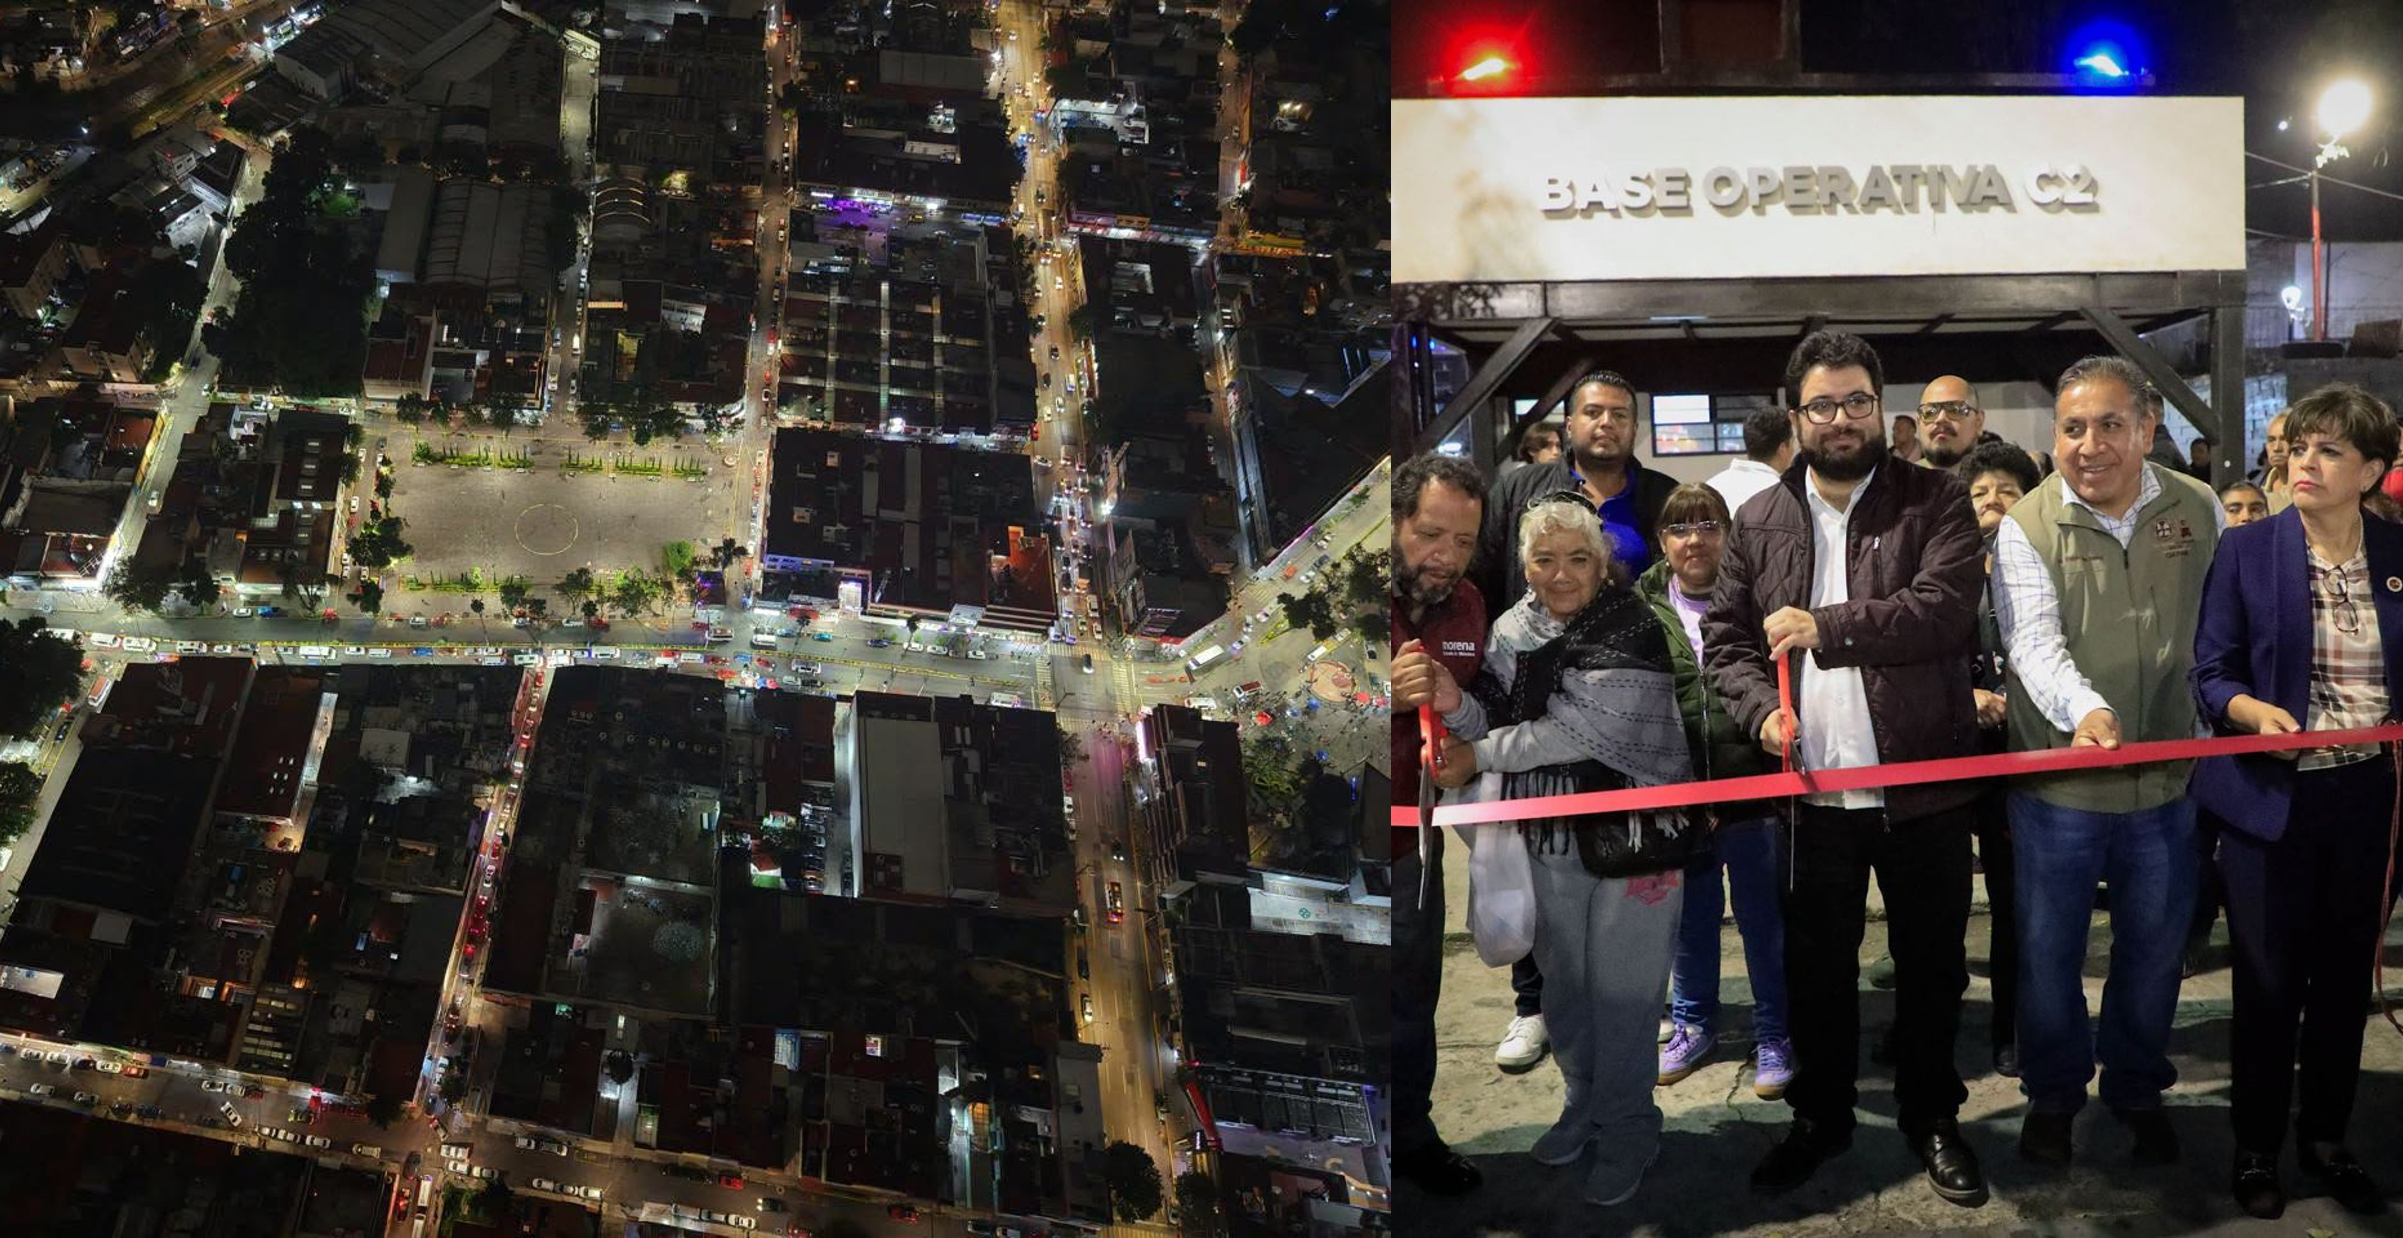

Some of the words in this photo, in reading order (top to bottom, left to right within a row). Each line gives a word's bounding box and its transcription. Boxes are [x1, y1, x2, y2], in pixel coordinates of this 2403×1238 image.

[1540, 167, 1691, 213] BASE
[1702, 164, 2013, 208] OPERATIVA
[2026, 164, 2096, 208] C2
[1442, 641, 1475, 651] morena
